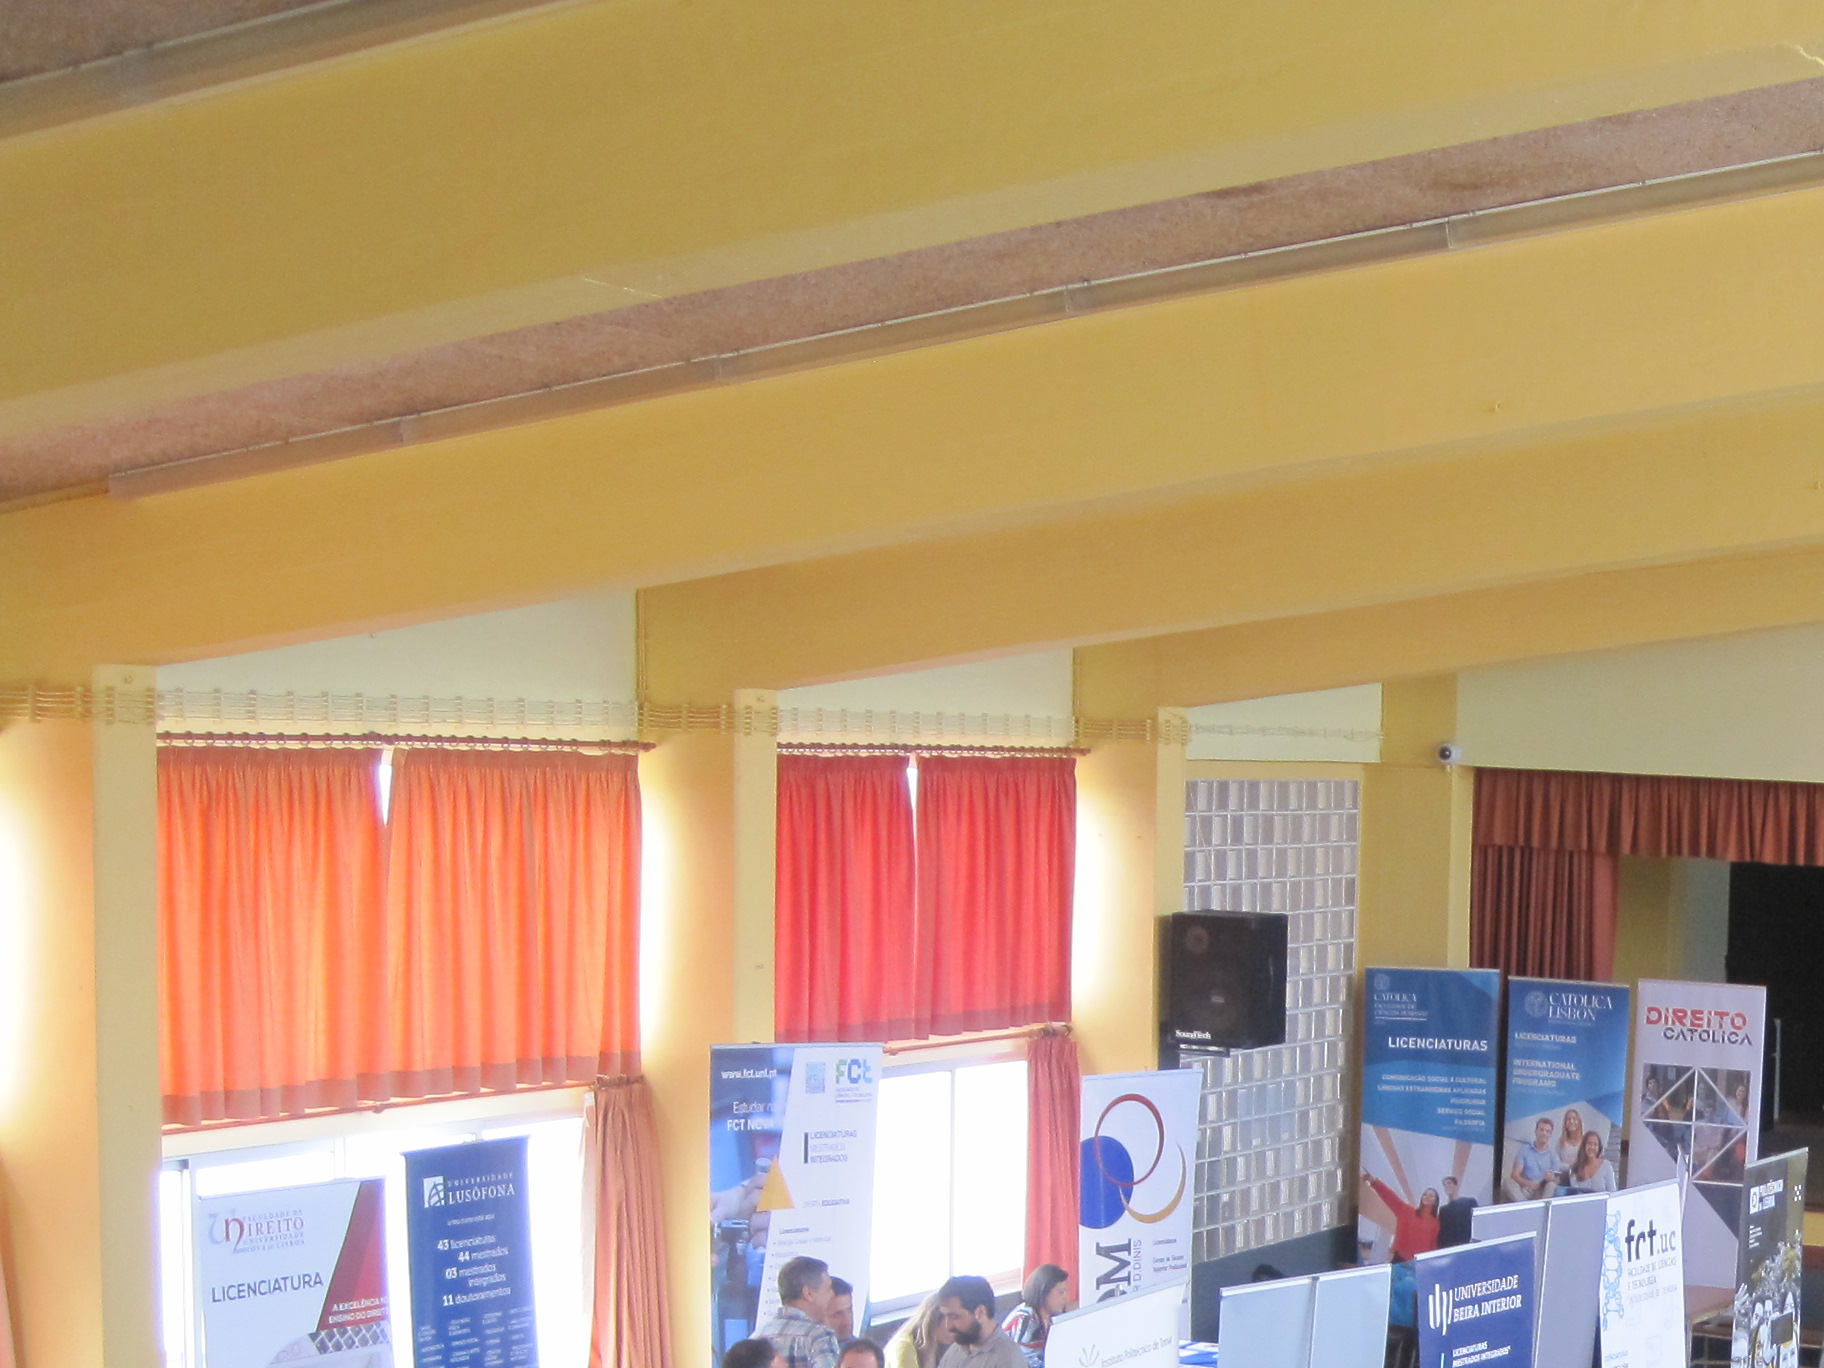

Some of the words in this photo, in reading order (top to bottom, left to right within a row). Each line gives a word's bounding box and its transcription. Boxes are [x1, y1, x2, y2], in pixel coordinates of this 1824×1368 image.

[1388, 1036, 1488, 1051] LICENCIATURAS
[727, 1119, 745, 1131] FCT
[449, 1183, 515, 1204] LUSÓFONA
[212, 1271, 324, 1303] LICENCIATURA
[1454, 1275, 1519, 1301] UNIVERSIDADE
[1453, 1304, 1480, 1322] BEIRA
[1481, 1294, 1522, 1316] INTERIOR
